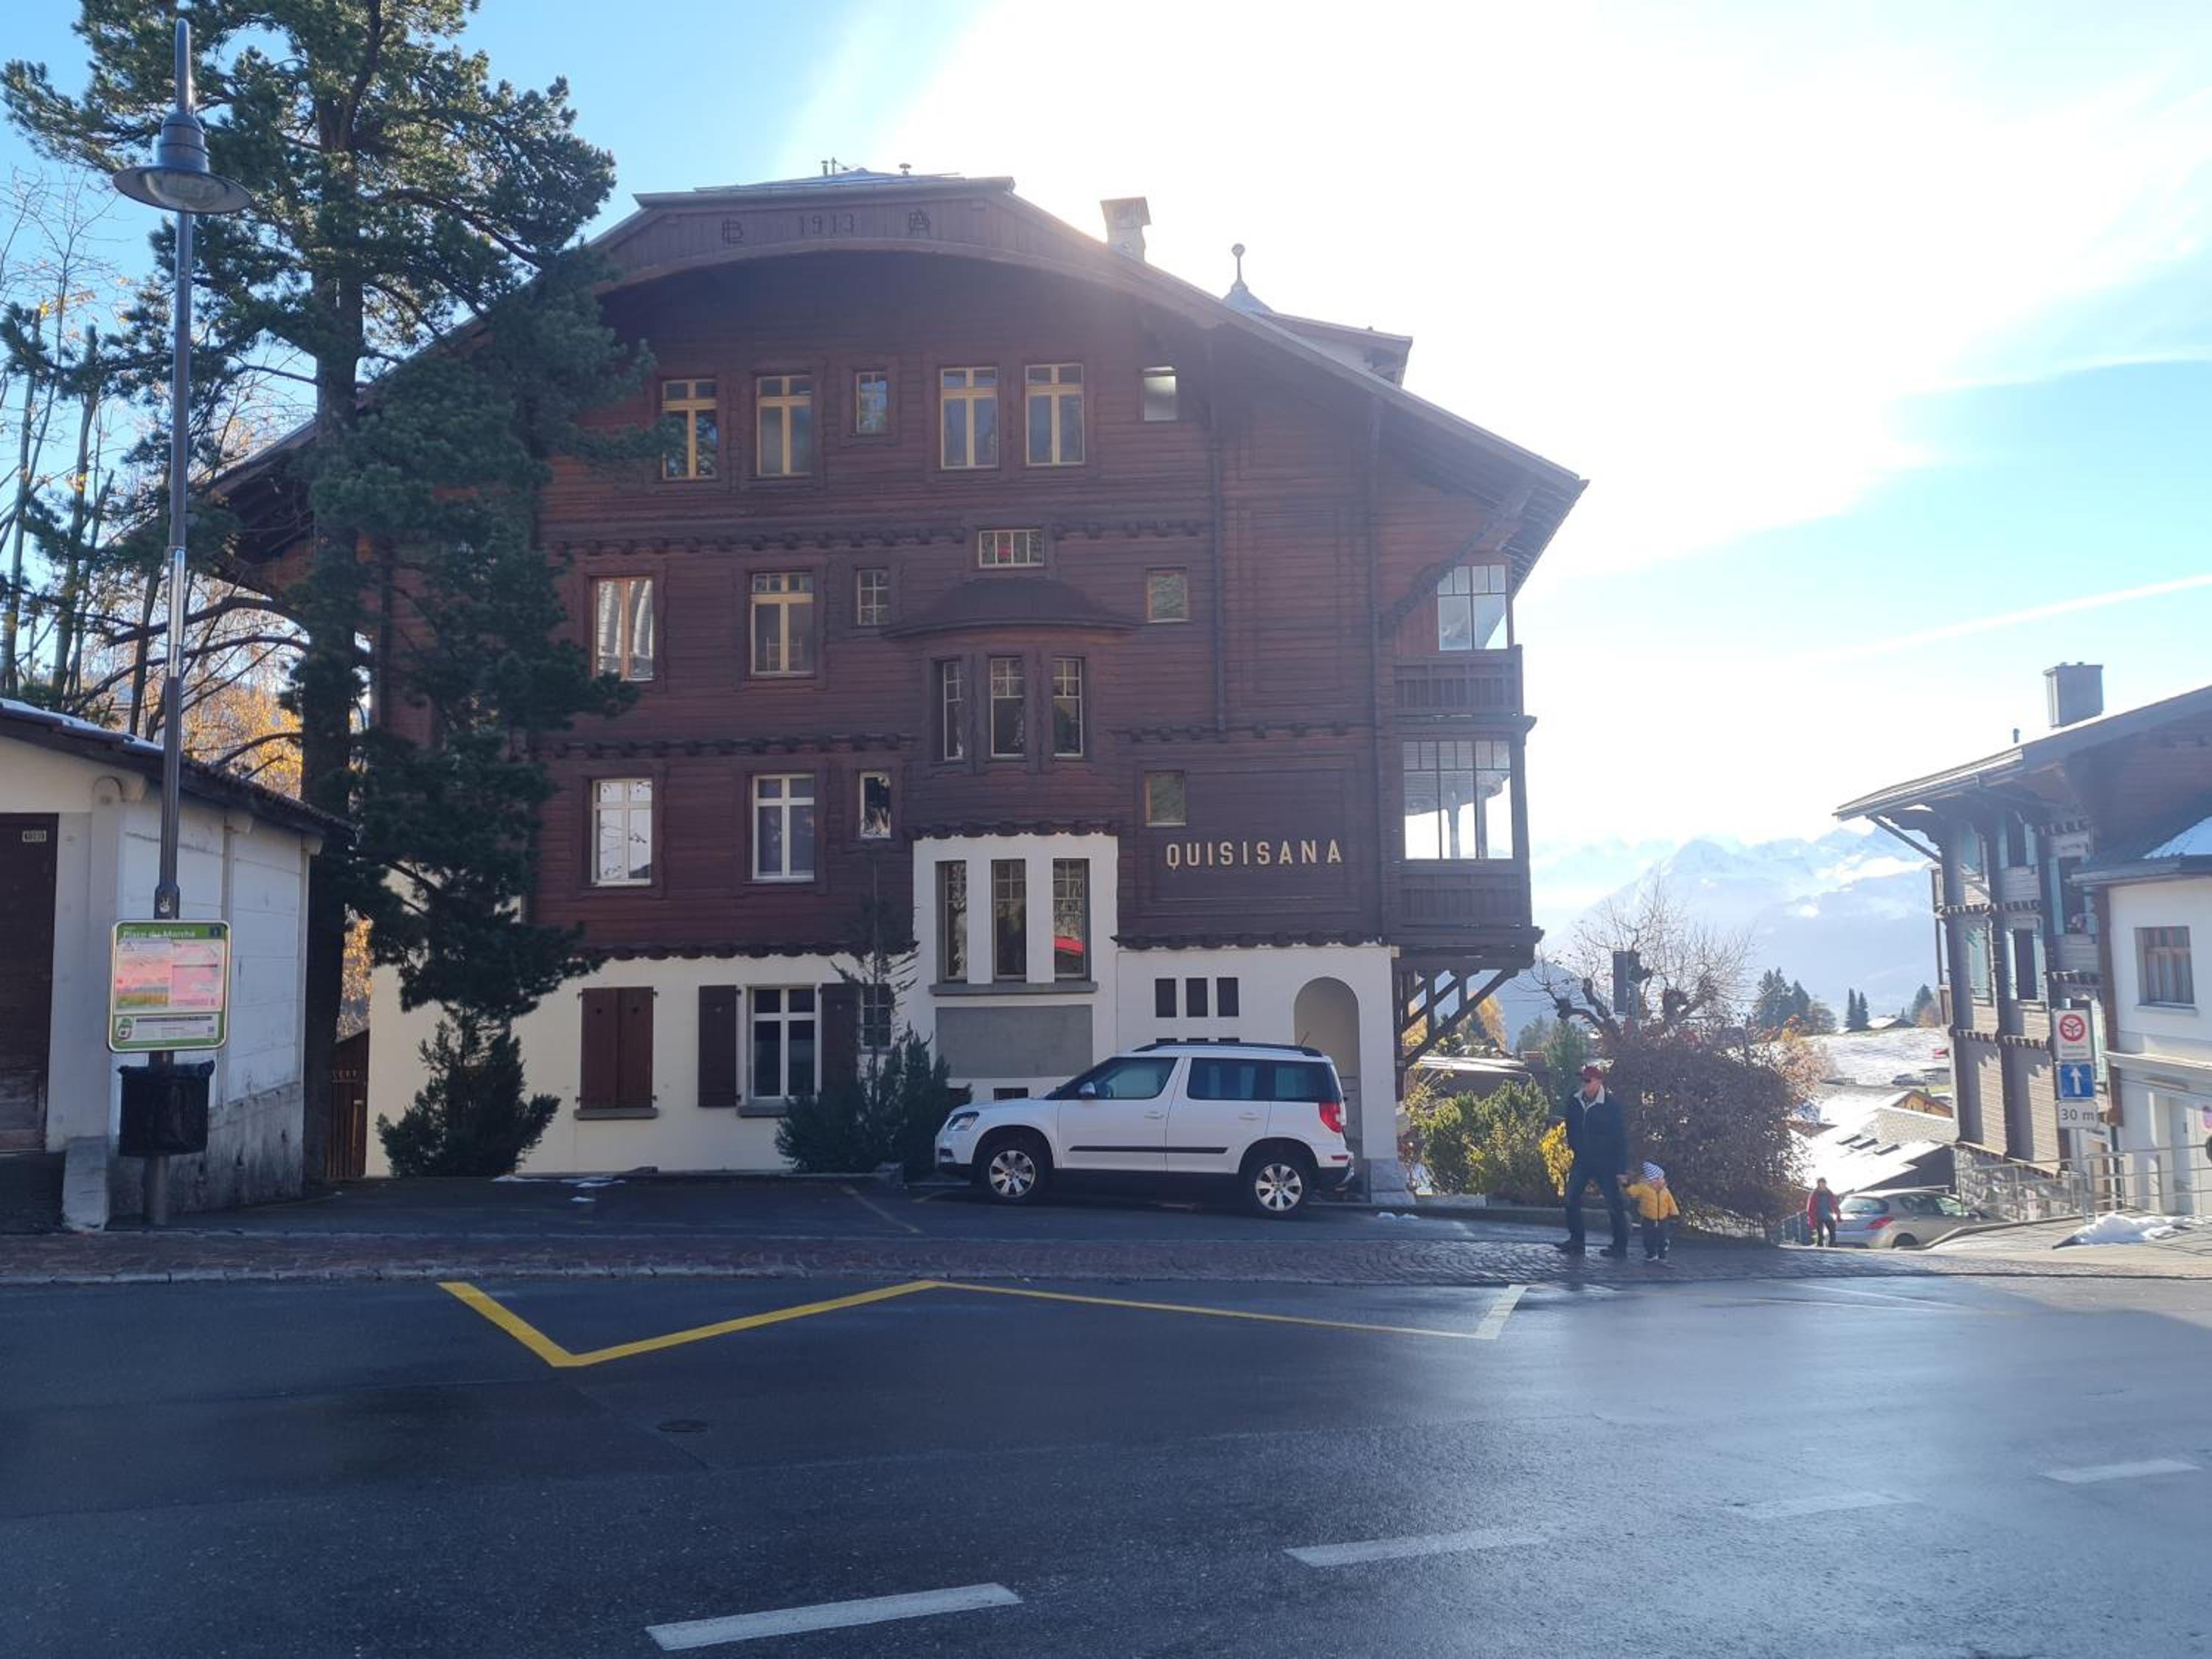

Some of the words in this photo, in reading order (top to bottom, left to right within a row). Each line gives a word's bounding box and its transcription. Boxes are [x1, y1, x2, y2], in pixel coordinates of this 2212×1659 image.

[1166, 839, 1342, 870] QUISISANA
[2061, 1108, 2078, 1121] 30
[2081, 1112, 2095, 1121] m
